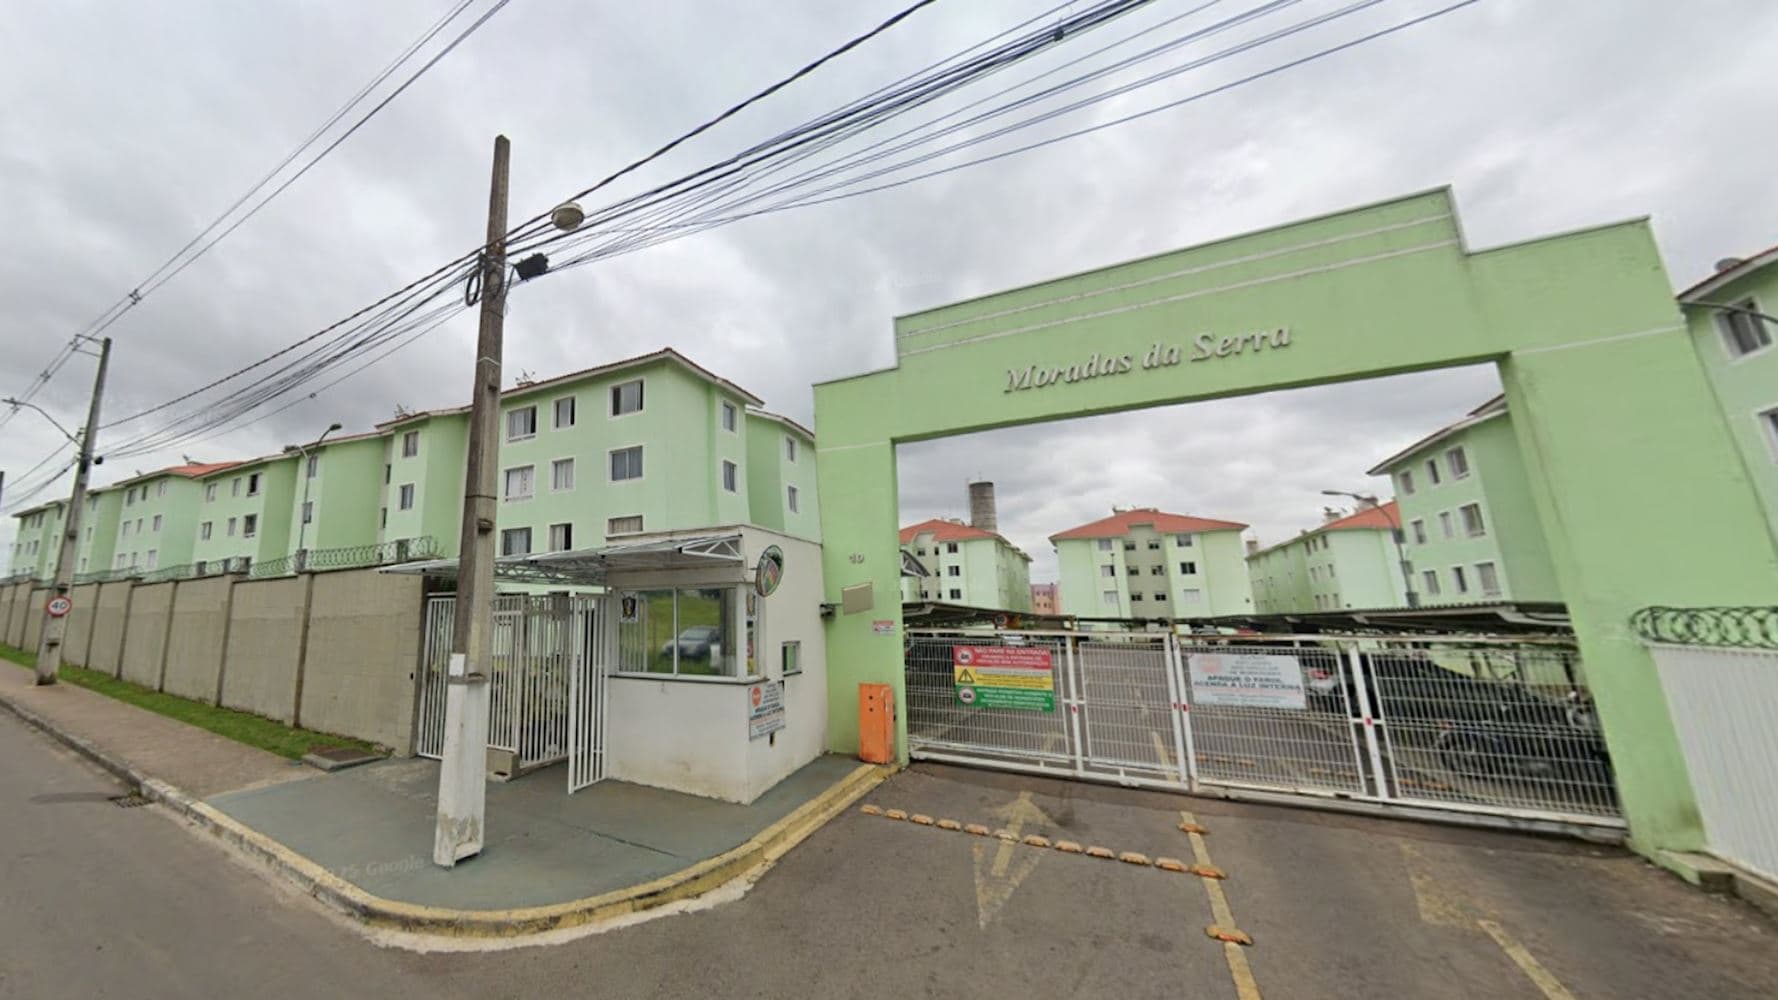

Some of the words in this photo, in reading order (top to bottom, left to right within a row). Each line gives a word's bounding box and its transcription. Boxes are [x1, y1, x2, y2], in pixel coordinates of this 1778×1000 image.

[1003, 351, 1132, 393] Moradas
[1141, 343, 1181, 369] da
[1191, 324, 1291, 363] Serra
[52, 601, 68, 610] 40
